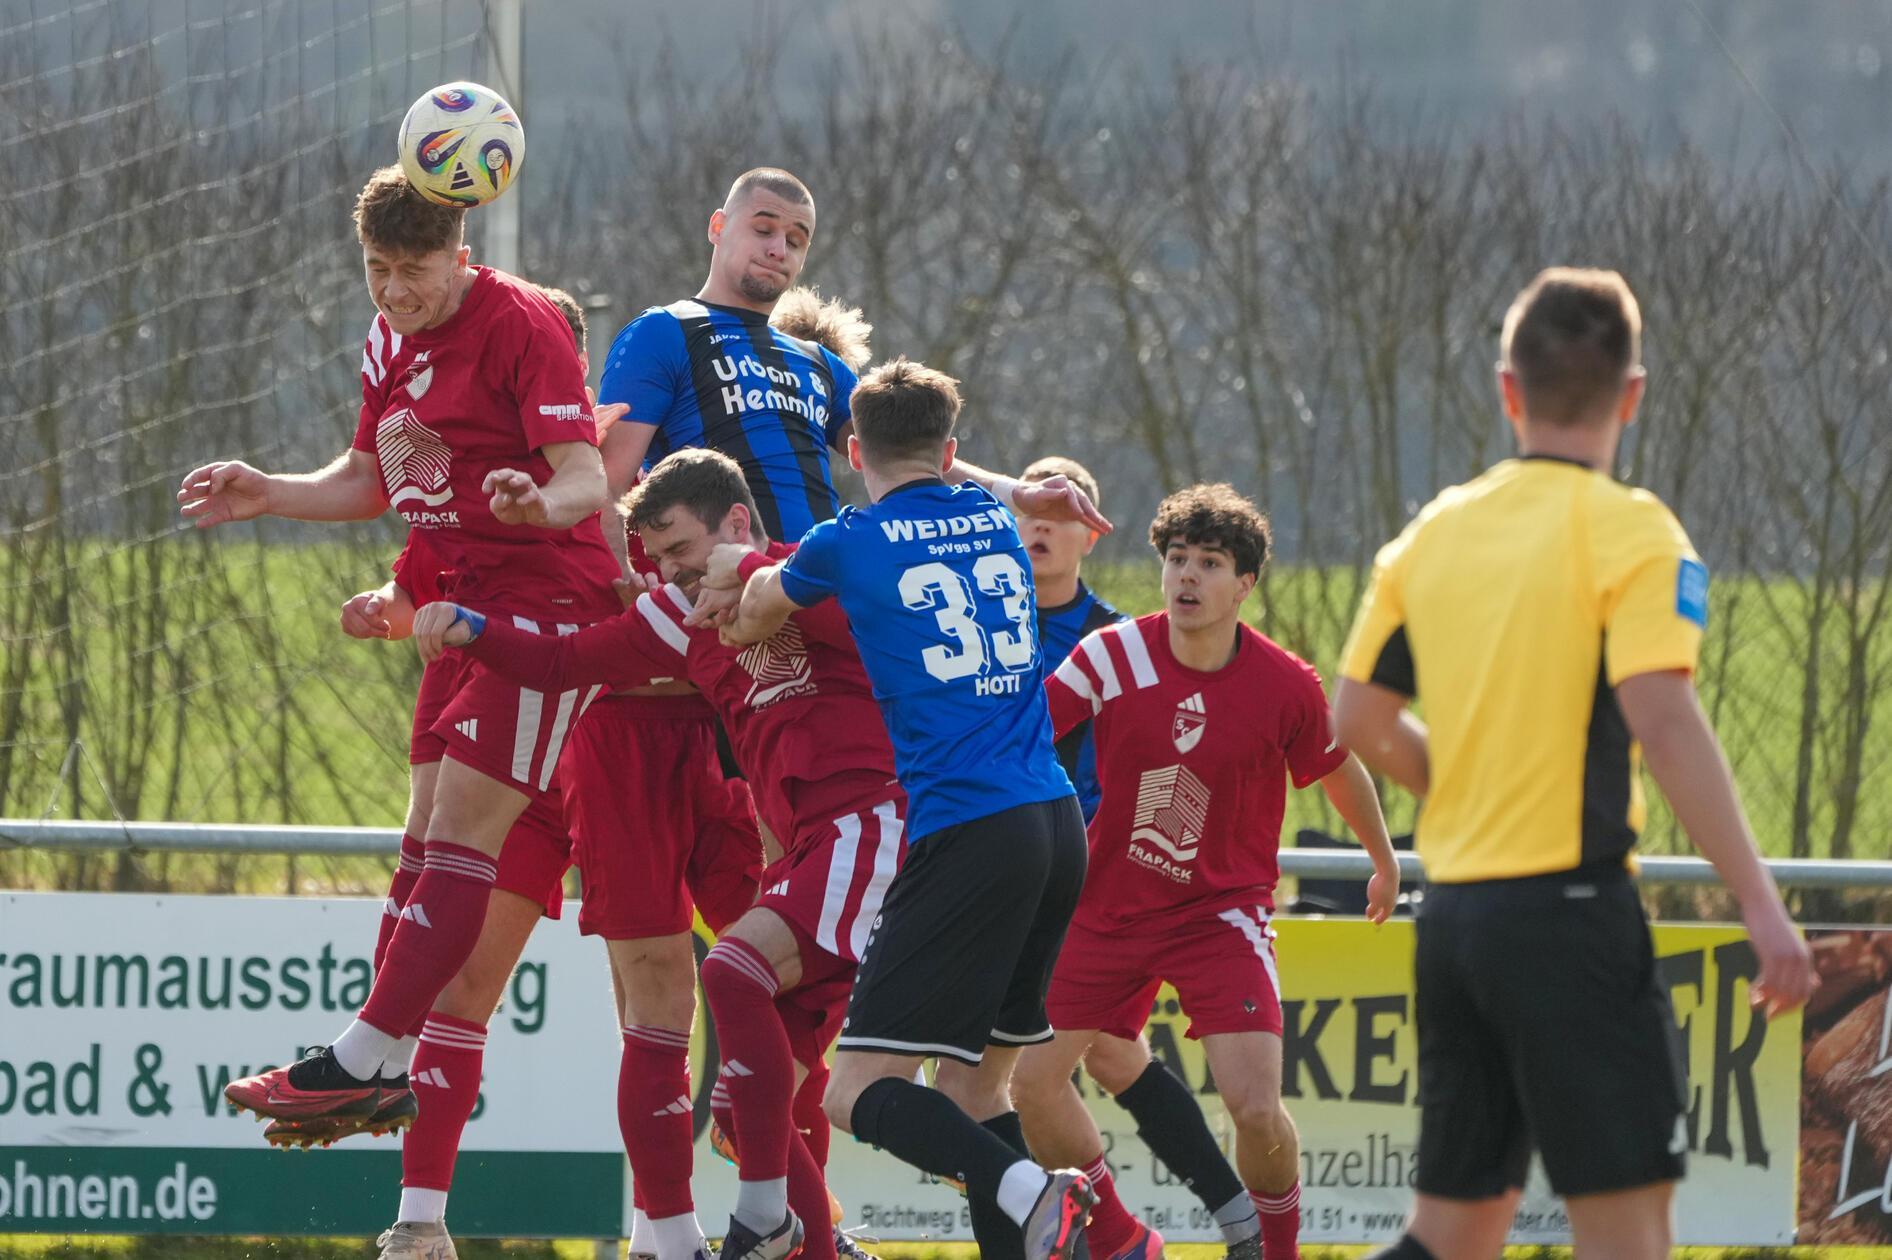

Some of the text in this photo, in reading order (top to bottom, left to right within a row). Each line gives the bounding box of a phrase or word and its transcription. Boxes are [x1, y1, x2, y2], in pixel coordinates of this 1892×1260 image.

[712, 355, 801, 388] Urban
[401, 511, 460, 524] RAPACK
[880, 507, 1013, 543] WEIDEN
[927, 539, 992, 557] SpVgg SV
[898, 553, 1036, 684] 33
[975, 674, 1021, 697] HOTI
[1129, 843, 1193, 880] FRAPACK
[127, 1043, 172, 1117] &
[862, 1204, 954, 1234] Richtweg
